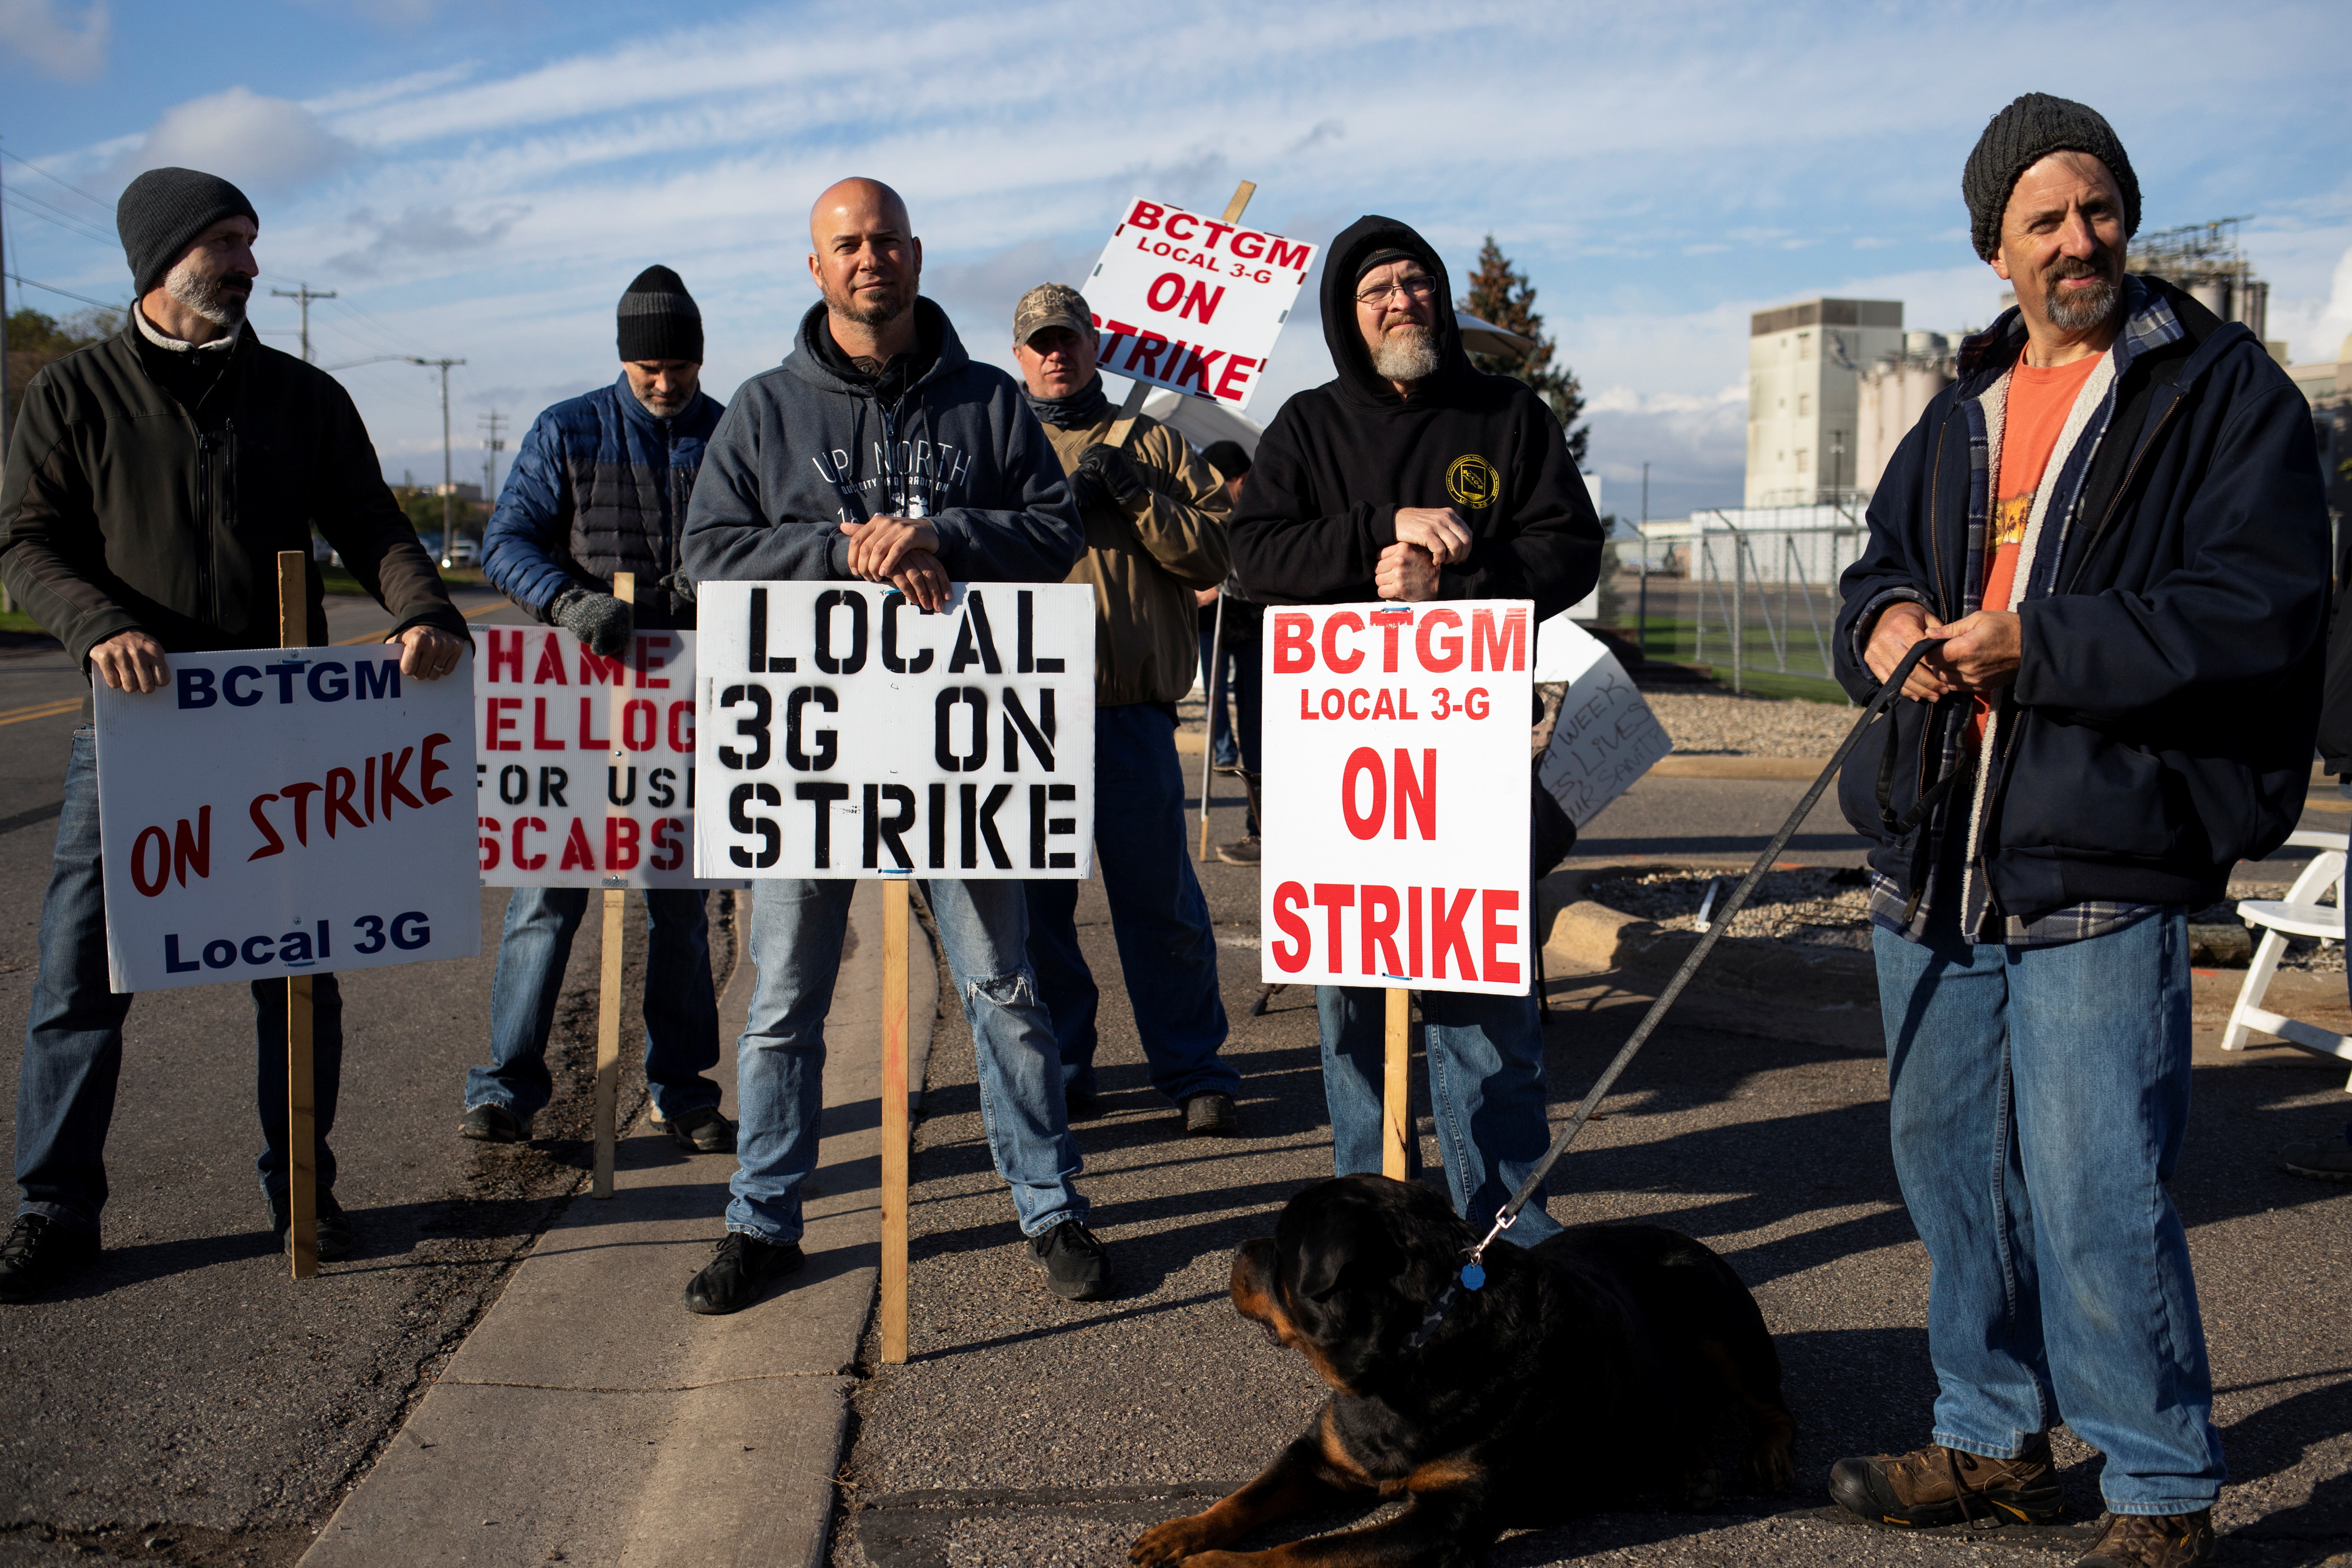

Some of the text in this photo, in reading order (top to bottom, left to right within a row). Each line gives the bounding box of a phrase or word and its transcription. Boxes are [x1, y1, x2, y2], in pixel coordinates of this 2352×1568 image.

[1127, 200, 1311, 270] BCTGM
[1137, 236, 1272, 284] LOCAL 3-G
[1147, 273, 1226, 325] ON
[812, 440, 971, 486] UP NORTH
[881, 477, 899, 486] ND
[906, 476, 948, 492] RADITON
[1463, 470, 1484, 490] BCTGM
[1459, 497, 1476, 507] LOCAL
[488, 628, 670, 689] HAME
[749, 588, 1065, 674] LOCAL
[1273, 608, 1527, 674] BCTGM
[176, 659, 402, 710] BCTGM
[1301, 687, 1490, 721] LOCAL 3-G
[1558, 673, 1630, 745] WEEK
[486, 697, 696, 753] ELLOG
[719, 684, 1056, 773] 3G ON
[131, 733, 453, 897] ON STRIKE
[1342, 746, 1437, 841] ON
[478, 816, 685, 871] SCABS
[729, 782, 1076, 870] STRIKE
[165, 911, 430, 974] Local 3G
[1271, 881, 1521, 984] STRIKE
